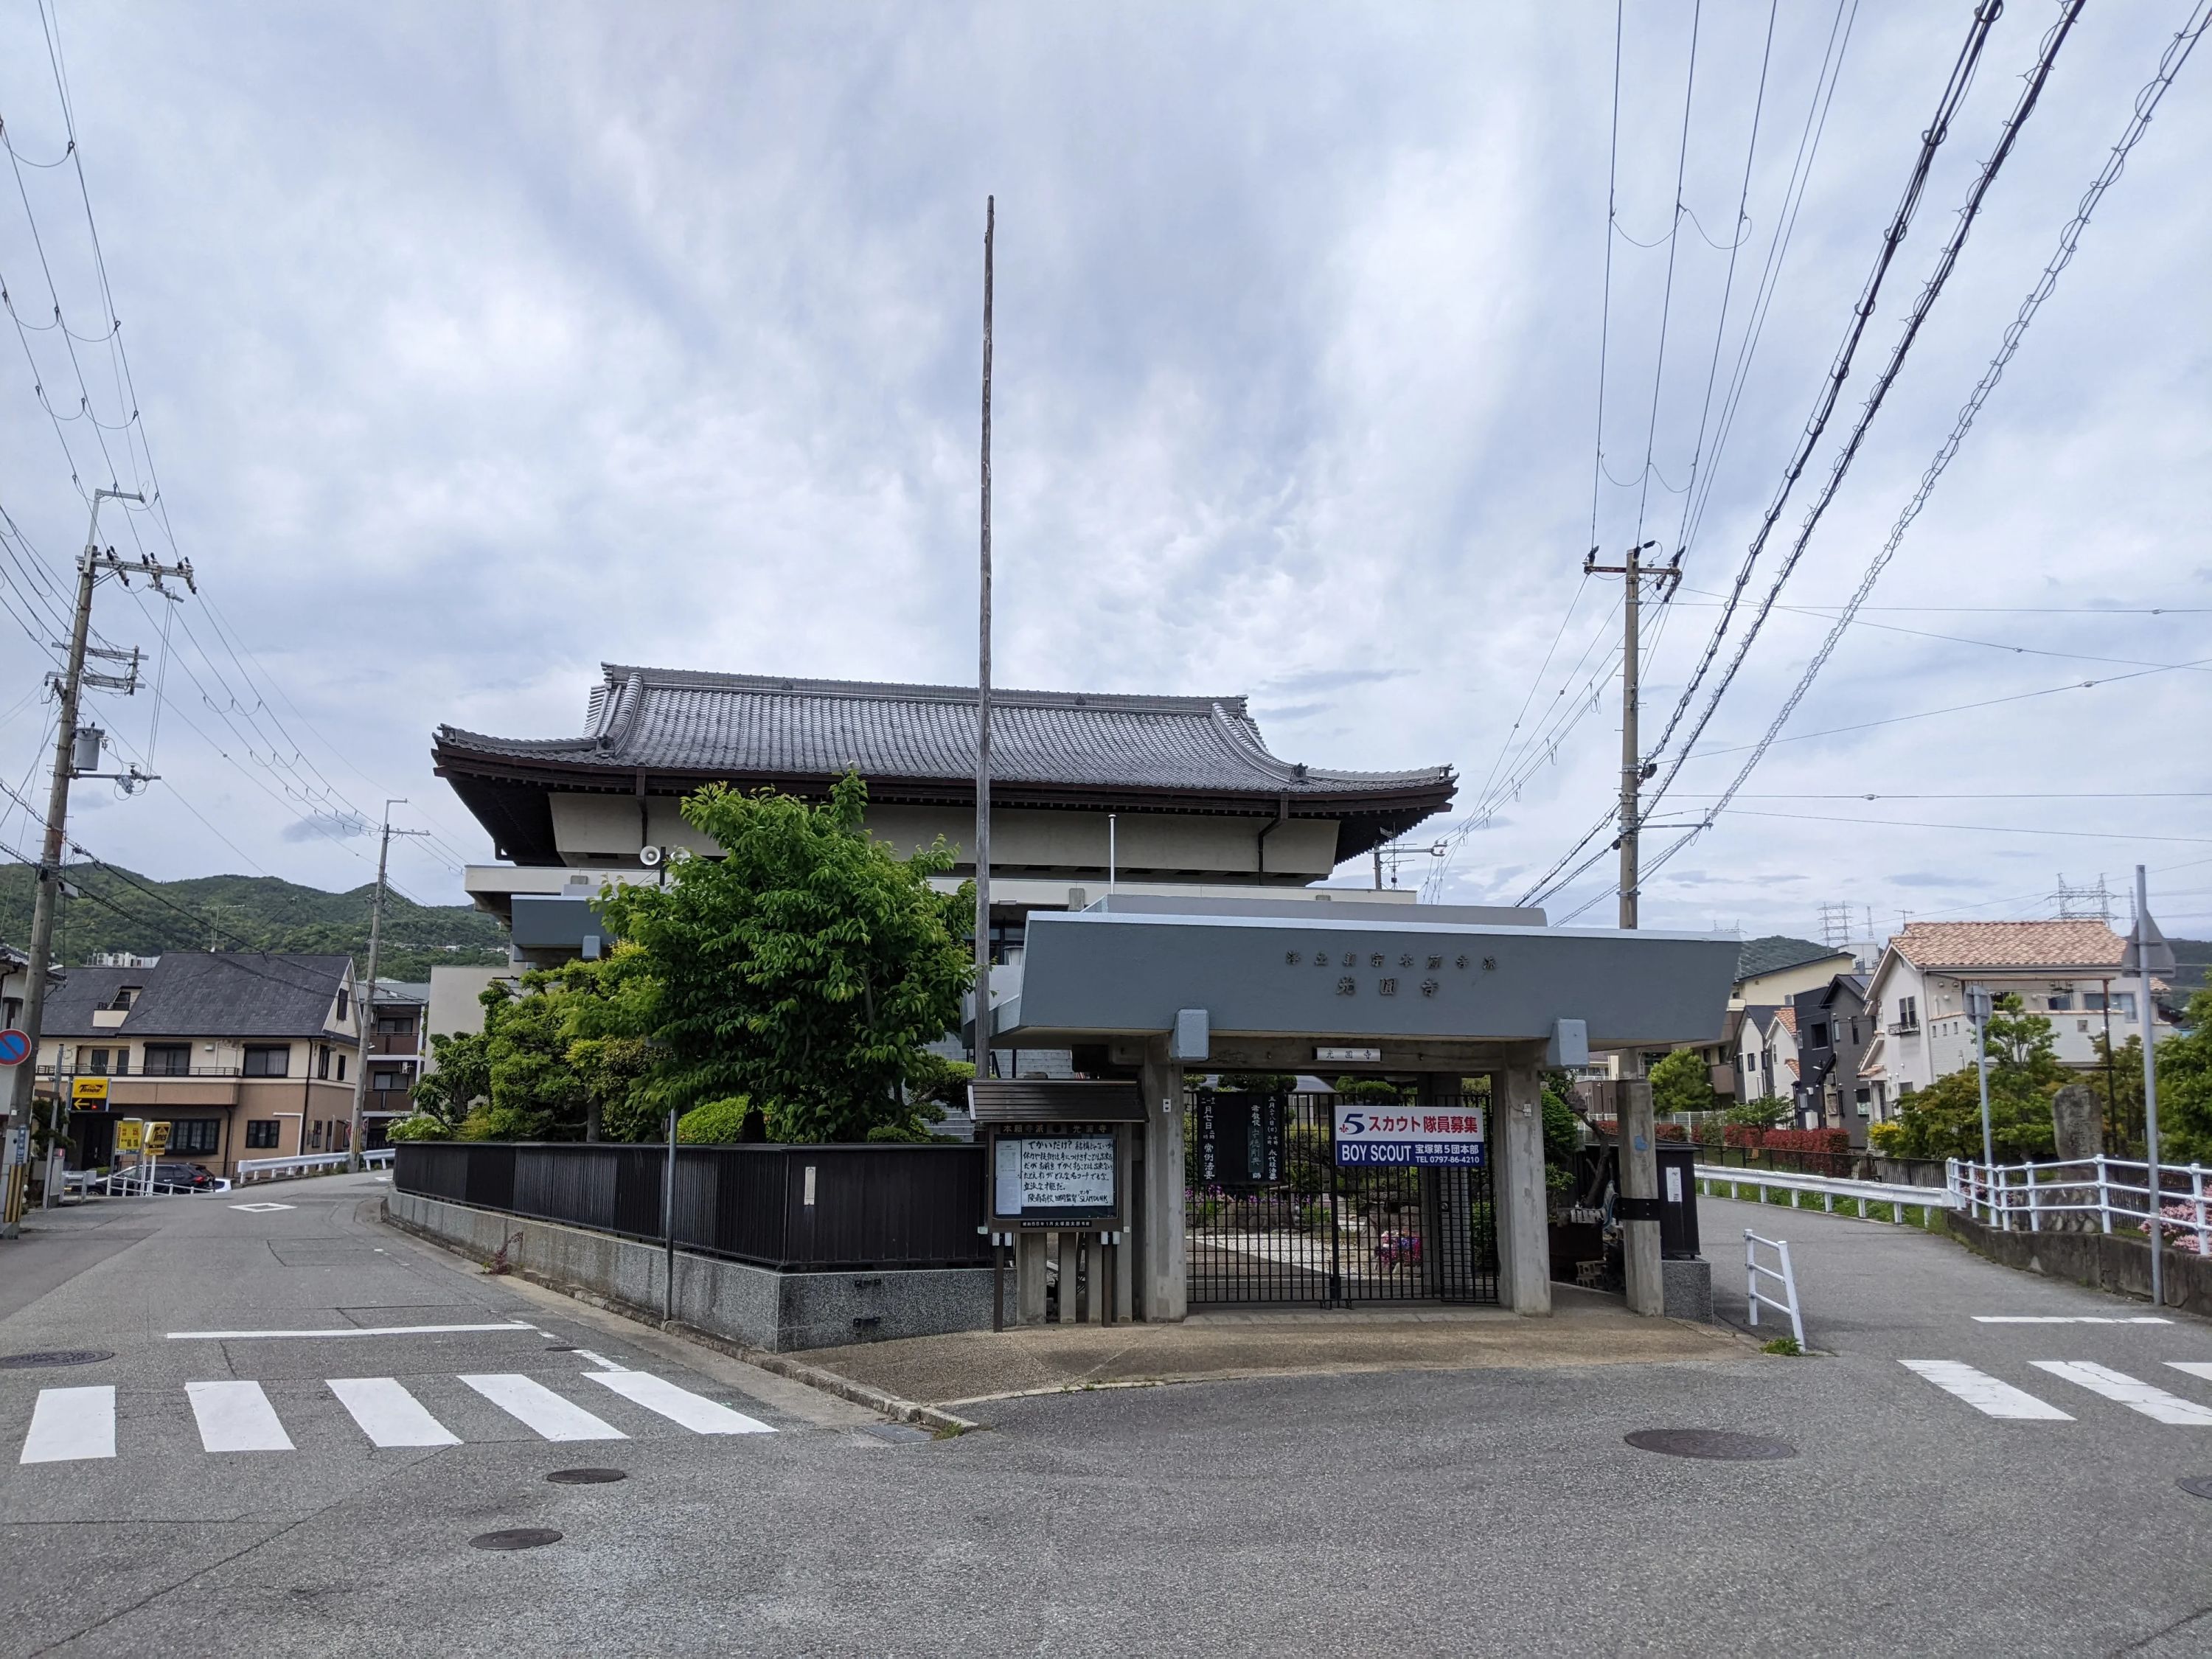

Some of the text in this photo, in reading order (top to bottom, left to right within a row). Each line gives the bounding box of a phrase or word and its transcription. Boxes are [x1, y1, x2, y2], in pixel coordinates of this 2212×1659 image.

[1368, 1116, 1478, 1134] スカウト 隊員募集
[1342, 1144, 1412, 1162] BOY SCOUT
[1415, 1144, 1479, 1155] 宝塚第5団本部
[1415, 1155, 1480, 1164] TEL 0797-86-4210
